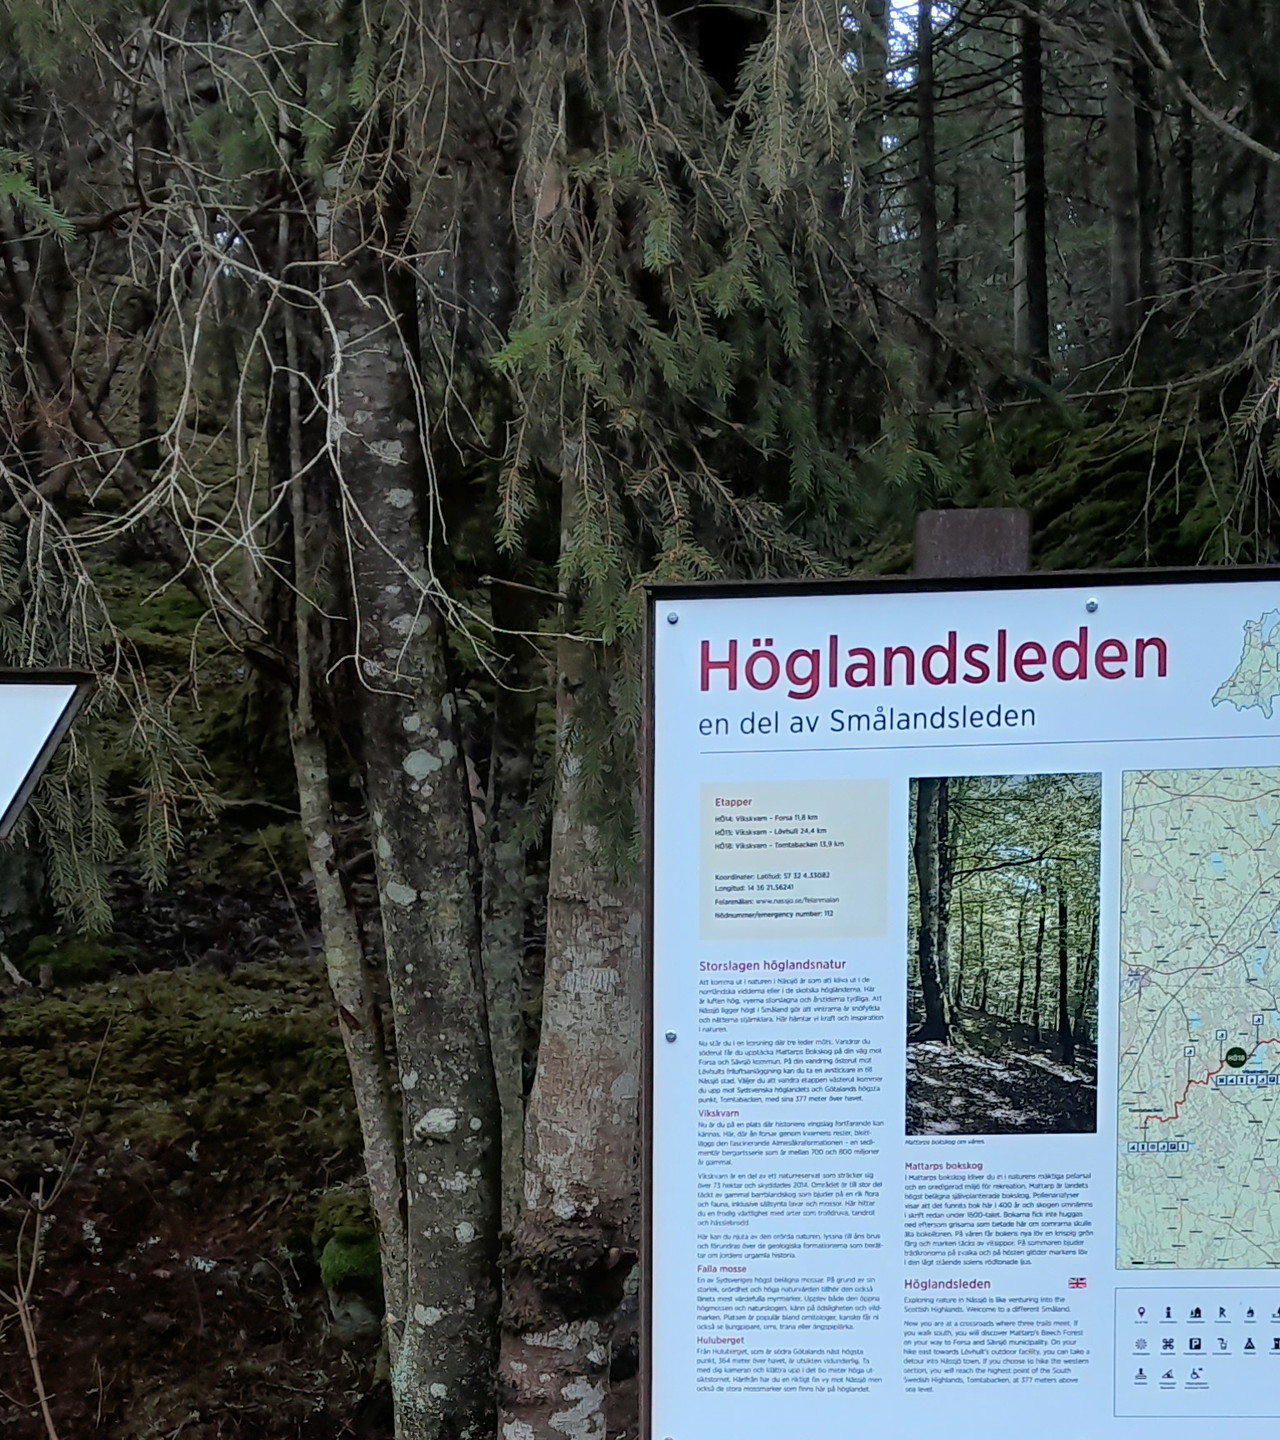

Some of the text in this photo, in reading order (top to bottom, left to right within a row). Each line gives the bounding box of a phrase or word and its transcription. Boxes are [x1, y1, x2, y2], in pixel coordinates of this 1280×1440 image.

[701, 626, 1167, 700] Höglandsleden
[699, 704, 1035, 736] en del av Smålandsleden
[715, 798, 752, 807] Etapper
[699, 959, 846, 973] Storslagen höglandsnatur
[698, 1109, 739, 1117] Vikskvarn
[905, 1161, 983, 1171] Mattarps bokskog
[697, 1264, 717, 1273] Falla
[904, 1278, 990, 1291] Höglandsleden
[697, 1336, 744, 1345] Huluberget
